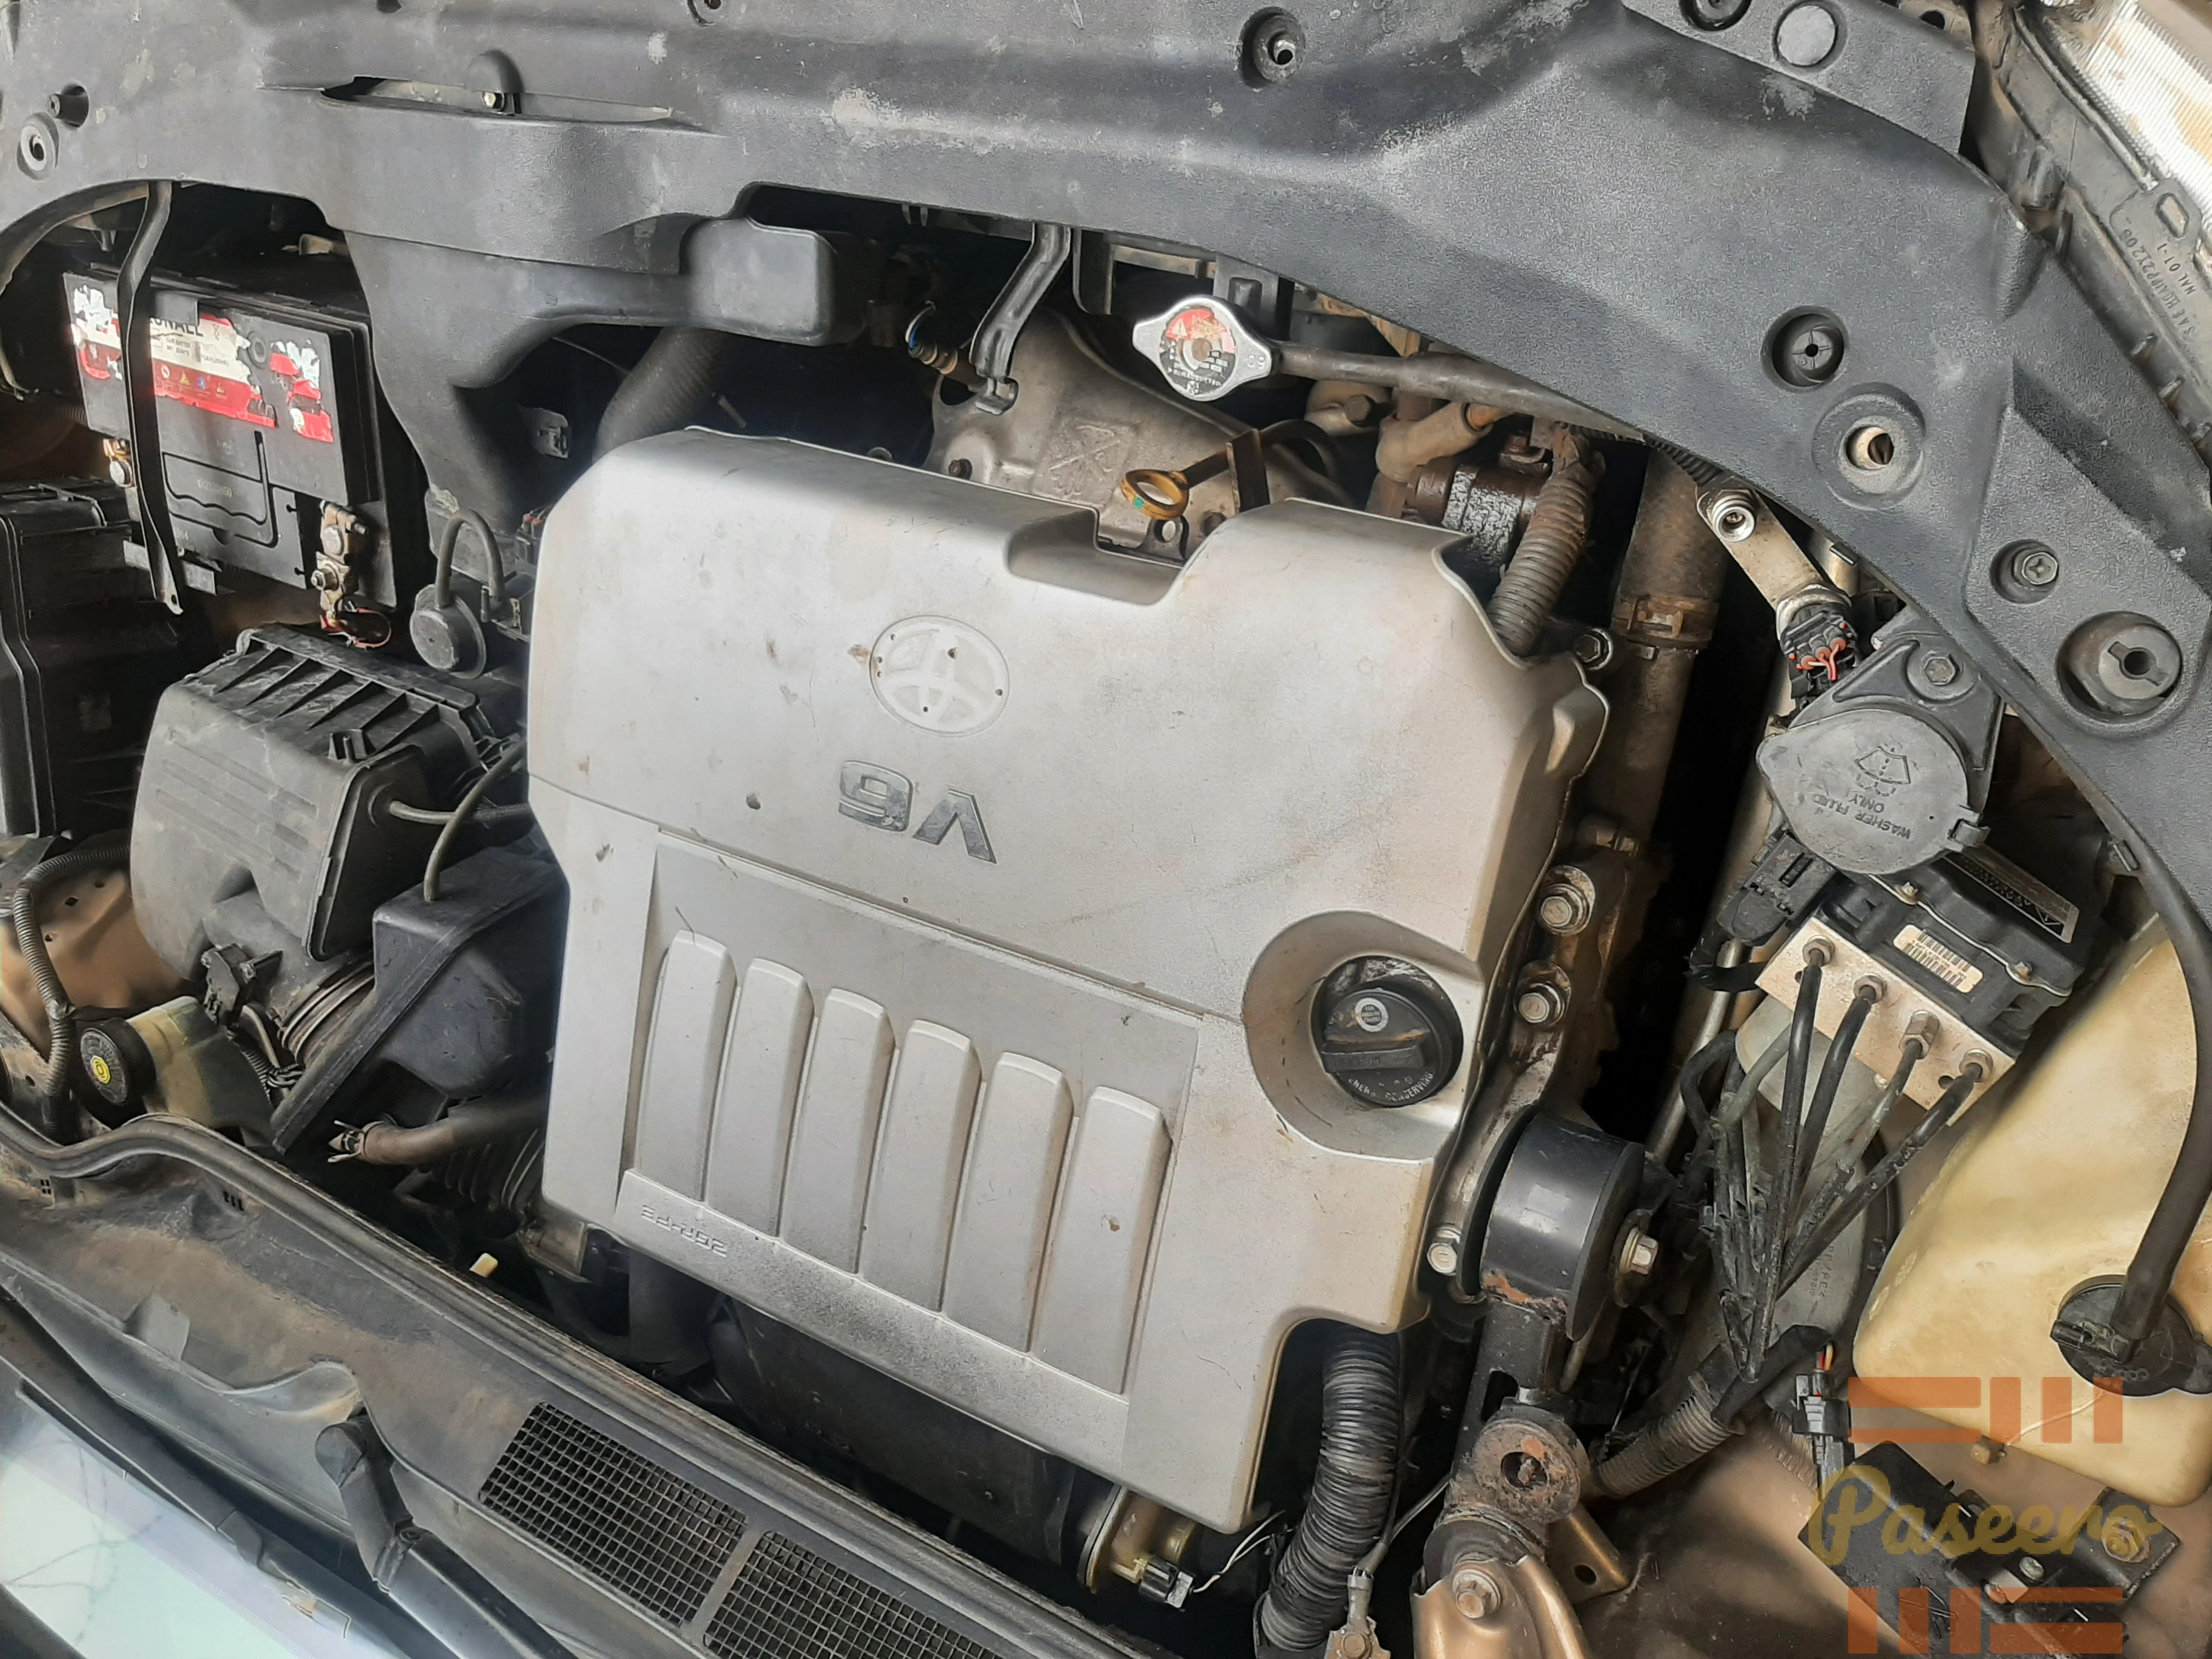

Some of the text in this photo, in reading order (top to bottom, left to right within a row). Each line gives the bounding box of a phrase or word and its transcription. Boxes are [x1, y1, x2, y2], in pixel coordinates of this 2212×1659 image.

[839, 759, 997, 864] V6
[1848, 793, 1884, 813] ONLY
[1854, 809, 1911, 840] WASHER
[641, 1205, 727, 1257] 2GR-FE
